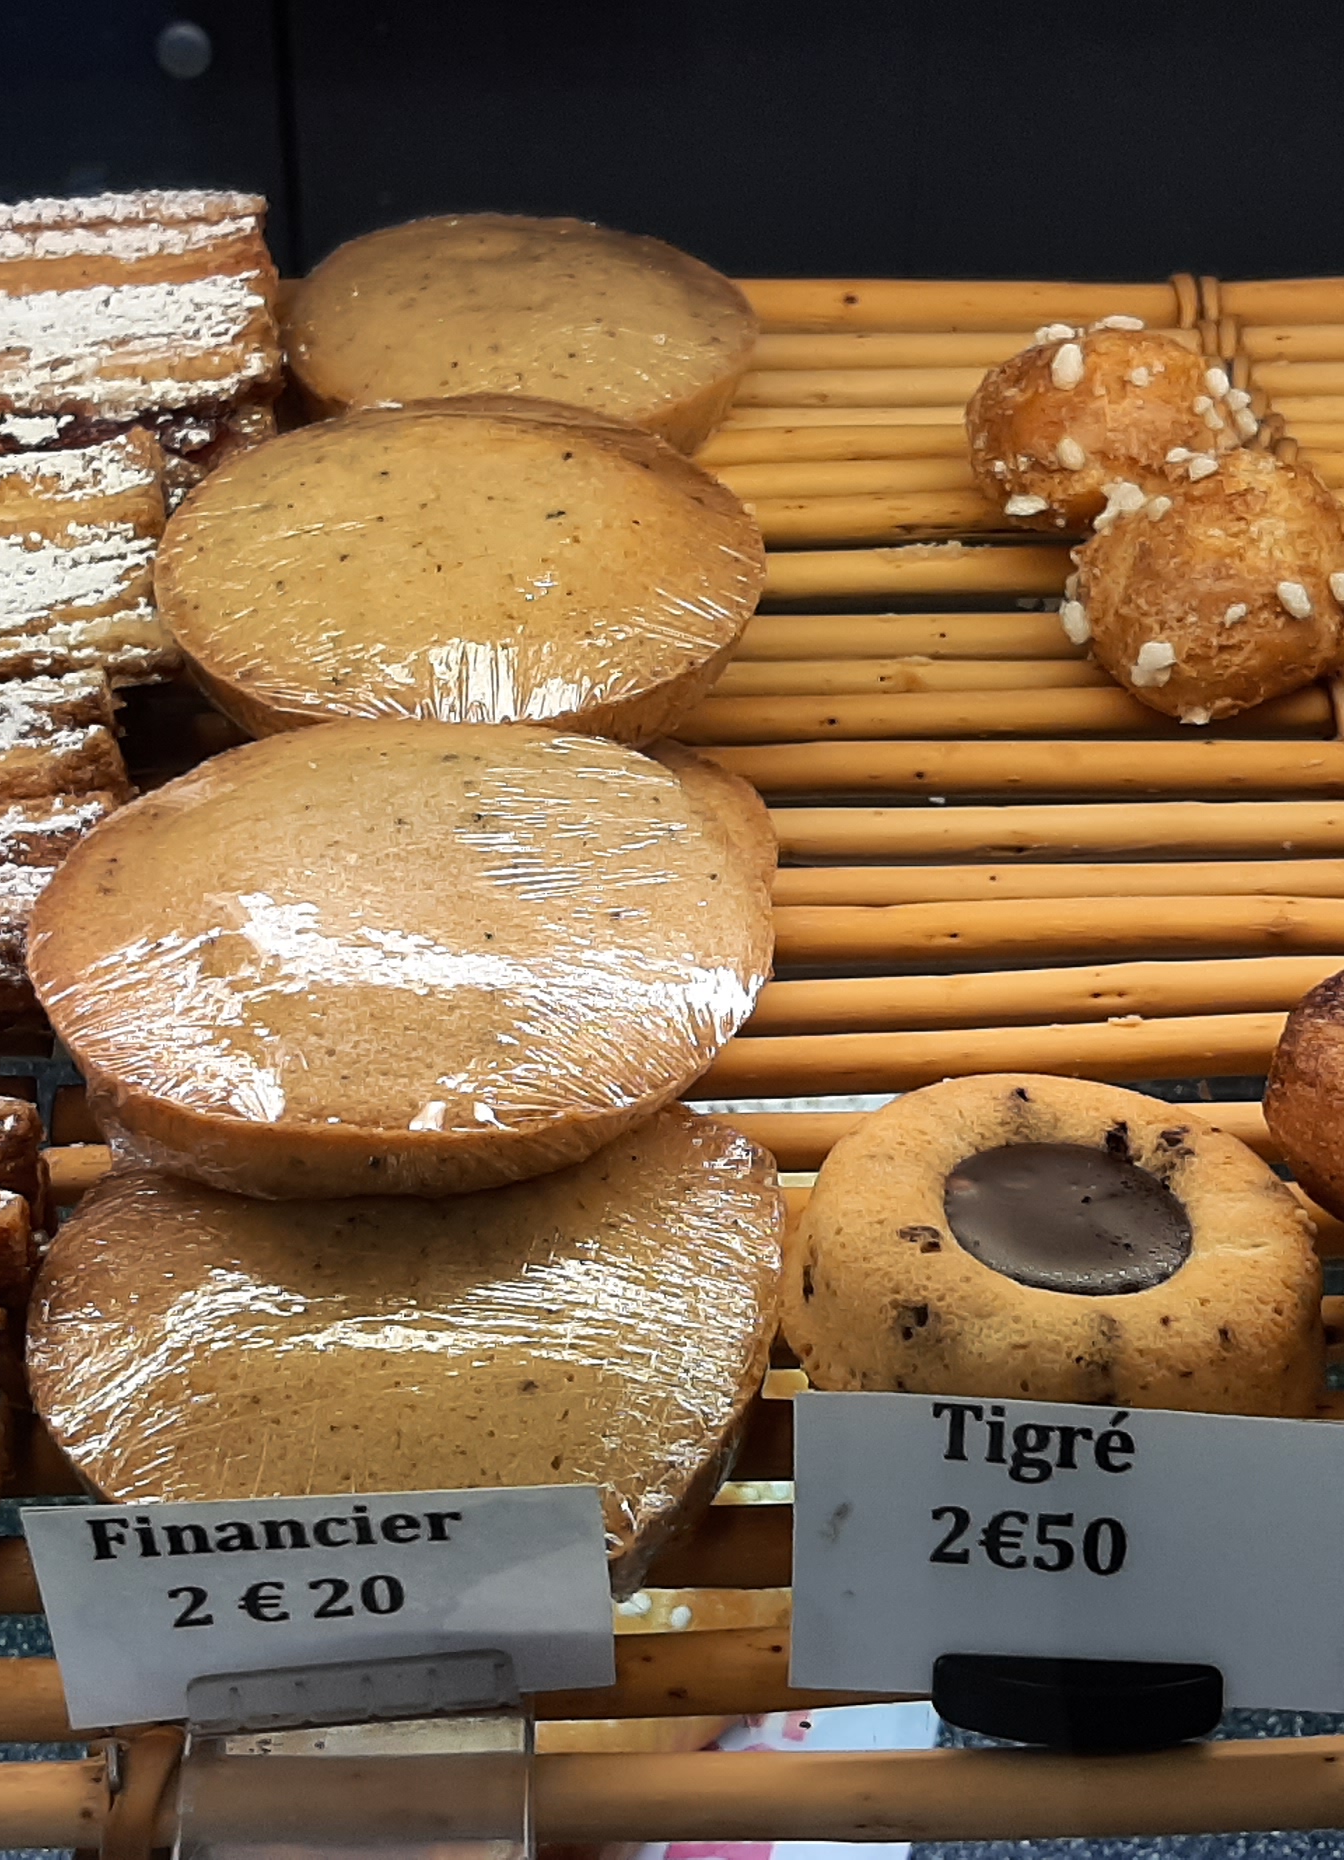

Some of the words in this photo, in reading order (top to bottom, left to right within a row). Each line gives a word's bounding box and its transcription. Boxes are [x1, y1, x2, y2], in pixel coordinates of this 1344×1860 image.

[932, 1402, 1136, 1484] Tigré
[86, 1505, 462, 1560] Financier
[929, 1505, 1128, 1576] 2€50
[167, 1586, 214, 1628] 2
[238, 1581, 290, 1623] €
[308, 1575, 406, 1619] 20
